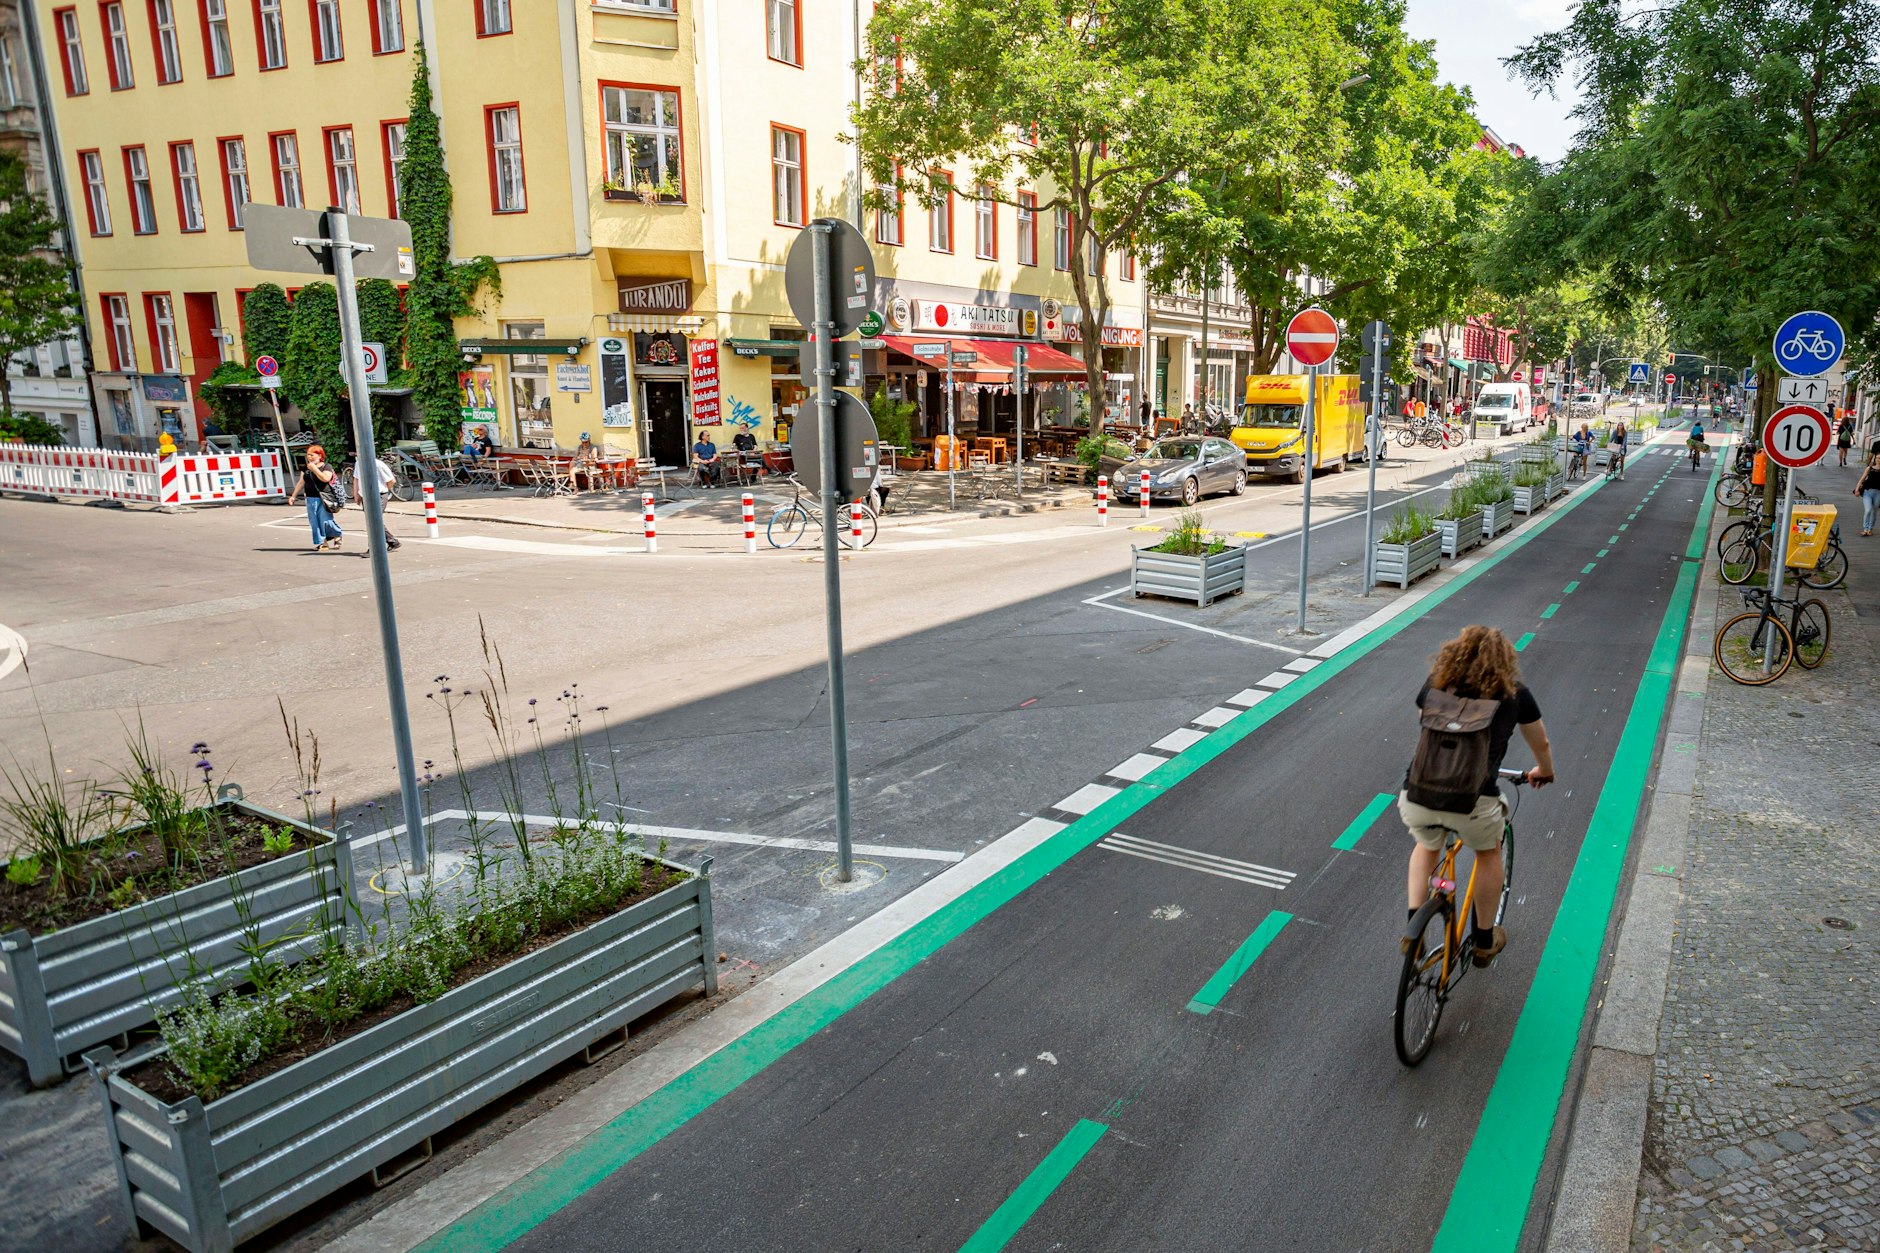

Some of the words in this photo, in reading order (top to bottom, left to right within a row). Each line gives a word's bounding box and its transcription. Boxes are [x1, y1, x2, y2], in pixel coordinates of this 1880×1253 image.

[961, 306, 978, 321] AKI
[982, 309, 1013, 323] TATSU
[970, 322, 986, 330] SUSHI
[992, 324, 1006, 332] MORE
[692, 343, 715, 355] Kaffee
[698, 355, 712, 365] Tee
[694, 367, 716, 378] Kakao
[1783, 424, 1814, 452] 10
